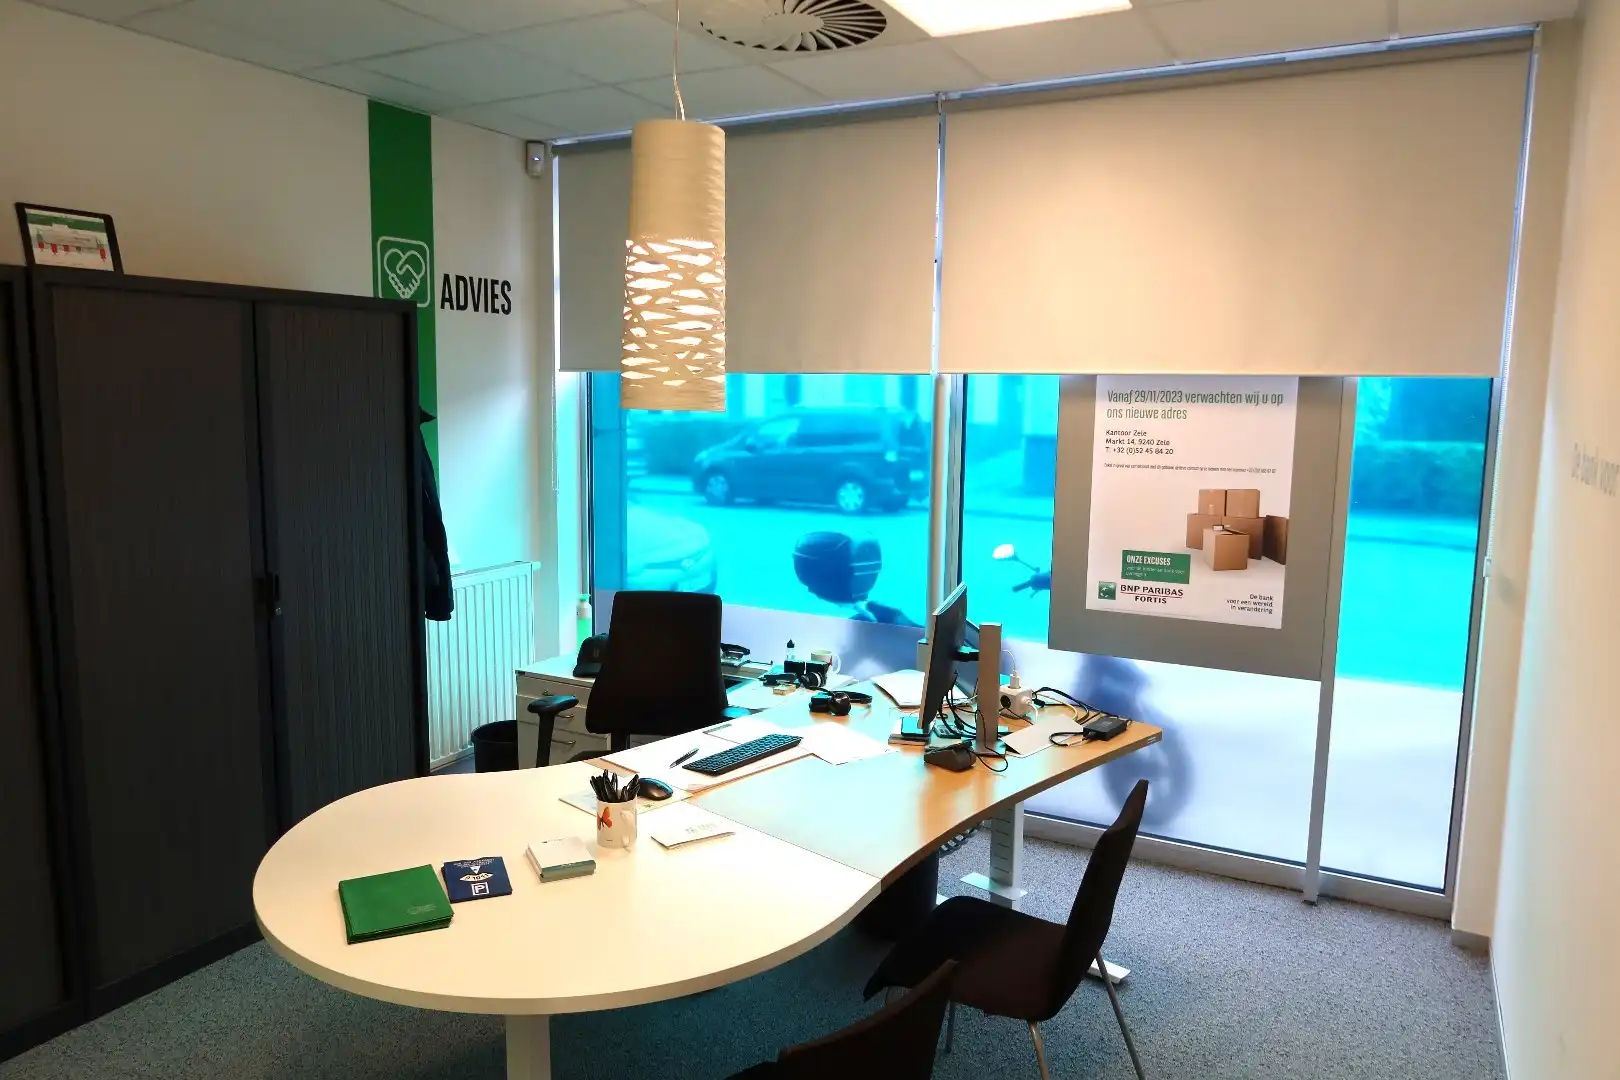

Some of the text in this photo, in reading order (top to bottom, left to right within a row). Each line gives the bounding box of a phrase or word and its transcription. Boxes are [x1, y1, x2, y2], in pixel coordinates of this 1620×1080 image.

[440, 273, 512, 315] ADVIES
[1107, 390, 1284, 406] Vanaf 29/11/2023 verwachten wij u op
[1106, 407, 1188, 420] ons nieuwe adres
[1138, 438, 1154, 446] 9240
[1113, 446, 1125, 454] +32
[1126, 447, 1144, 455] (0)52
[1145, 447, 1154, 455] 45
[1126, 554, 1171, 566] ONZE EXCUSES
[1120, 584, 1184, 597] BNP PARIBAS
[1134, 595, 1168, 605] FORTIS
